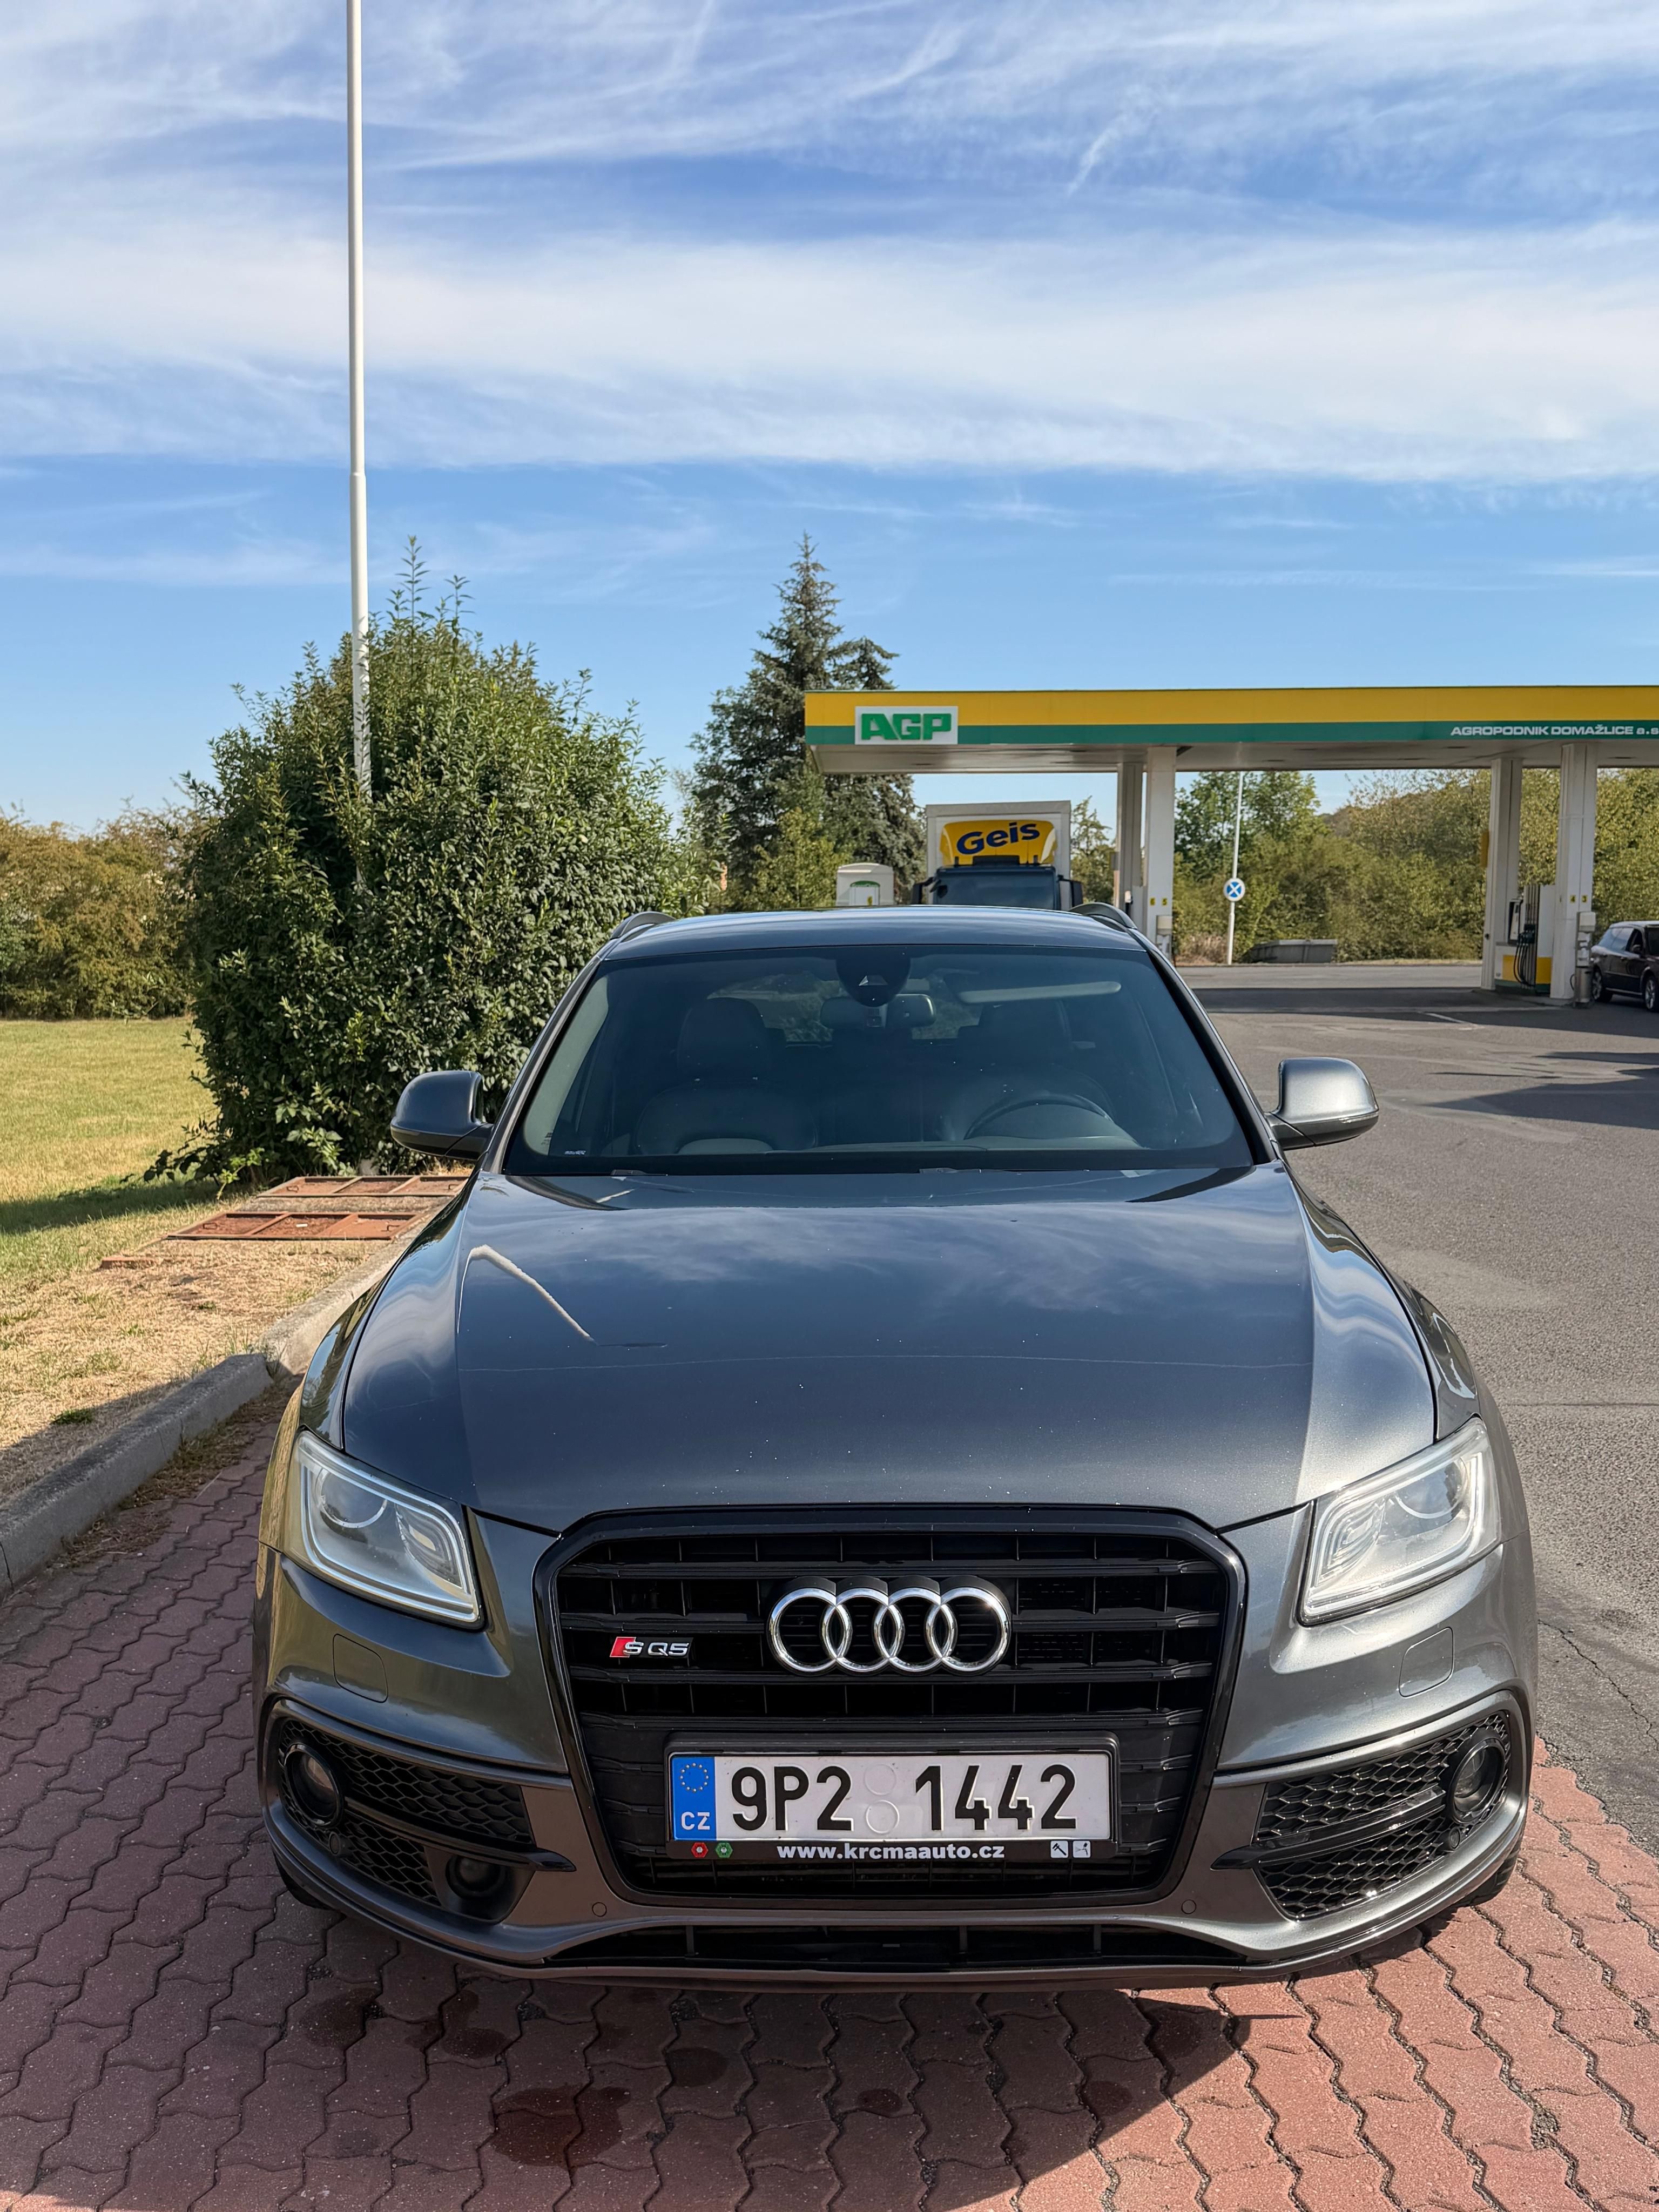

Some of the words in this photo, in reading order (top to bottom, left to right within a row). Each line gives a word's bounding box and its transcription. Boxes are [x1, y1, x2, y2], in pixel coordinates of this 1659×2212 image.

[861, 713, 952, 740] AGP
[1451, 726, 1549, 736] AGROPODNIK
[1551, 724, 1634, 735] DOMAŽLICE
[956, 822, 1040, 855] Geis
[731, 1766, 853, 1831] 9P2
[915, 1764, 1078, 1831] 1442
[681, 1812, 711, 1831] CZ
[777, 1843, 1004, 1859] www.krcmaauto.cz
